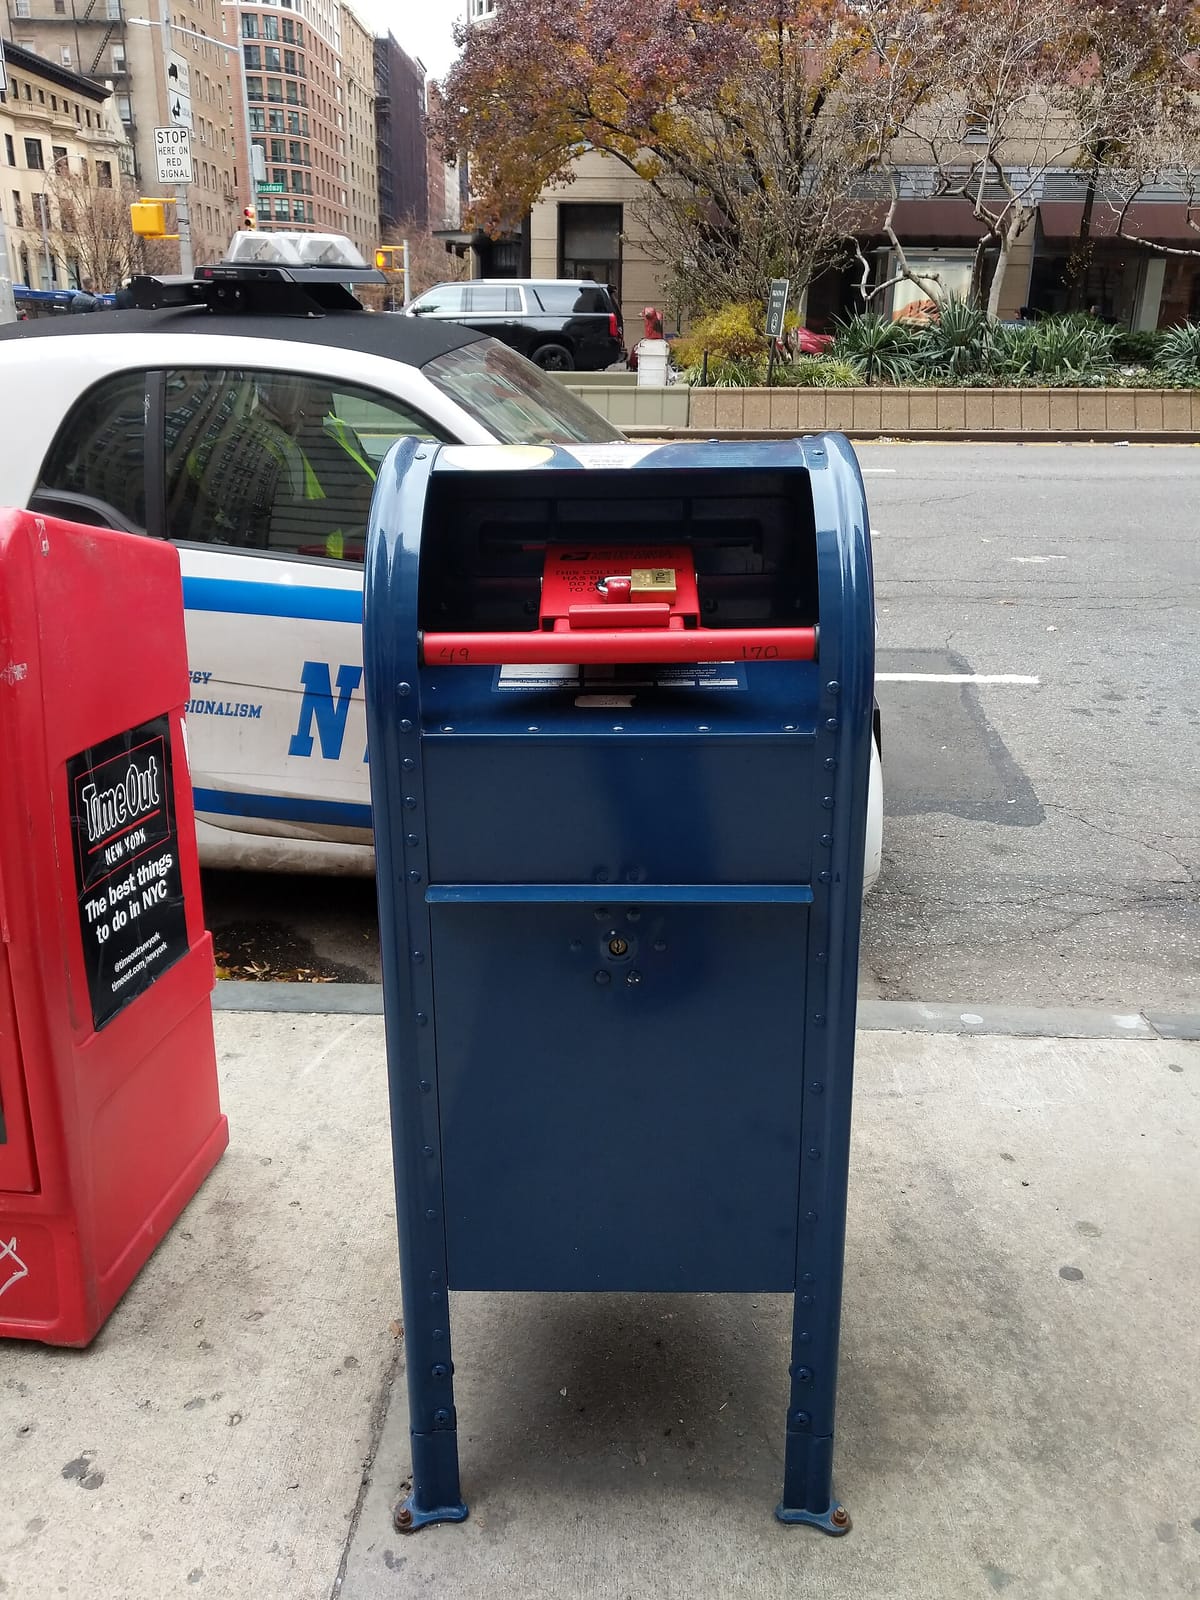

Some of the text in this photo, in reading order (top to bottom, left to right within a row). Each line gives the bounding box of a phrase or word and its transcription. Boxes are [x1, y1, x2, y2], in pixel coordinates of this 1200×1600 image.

[157, 131, 187, 144] STOP
[158, 146, 189, 156] HERE ON
[160, 169, 190, 179] SIGNAL
[166, 158, 182, 167] RED
[742, 645, 779, 660] 170
[288, 661, 368, 763] N
[105, 828, 146, 866] NEW YORK
[85, 853, 173, 923] The best things
[96, 879, 167, 944] to do in NYC
[112, 941, 168, 992] timeout.com/newyork
[115, 931, 161, 973] @timeoutnewyork
